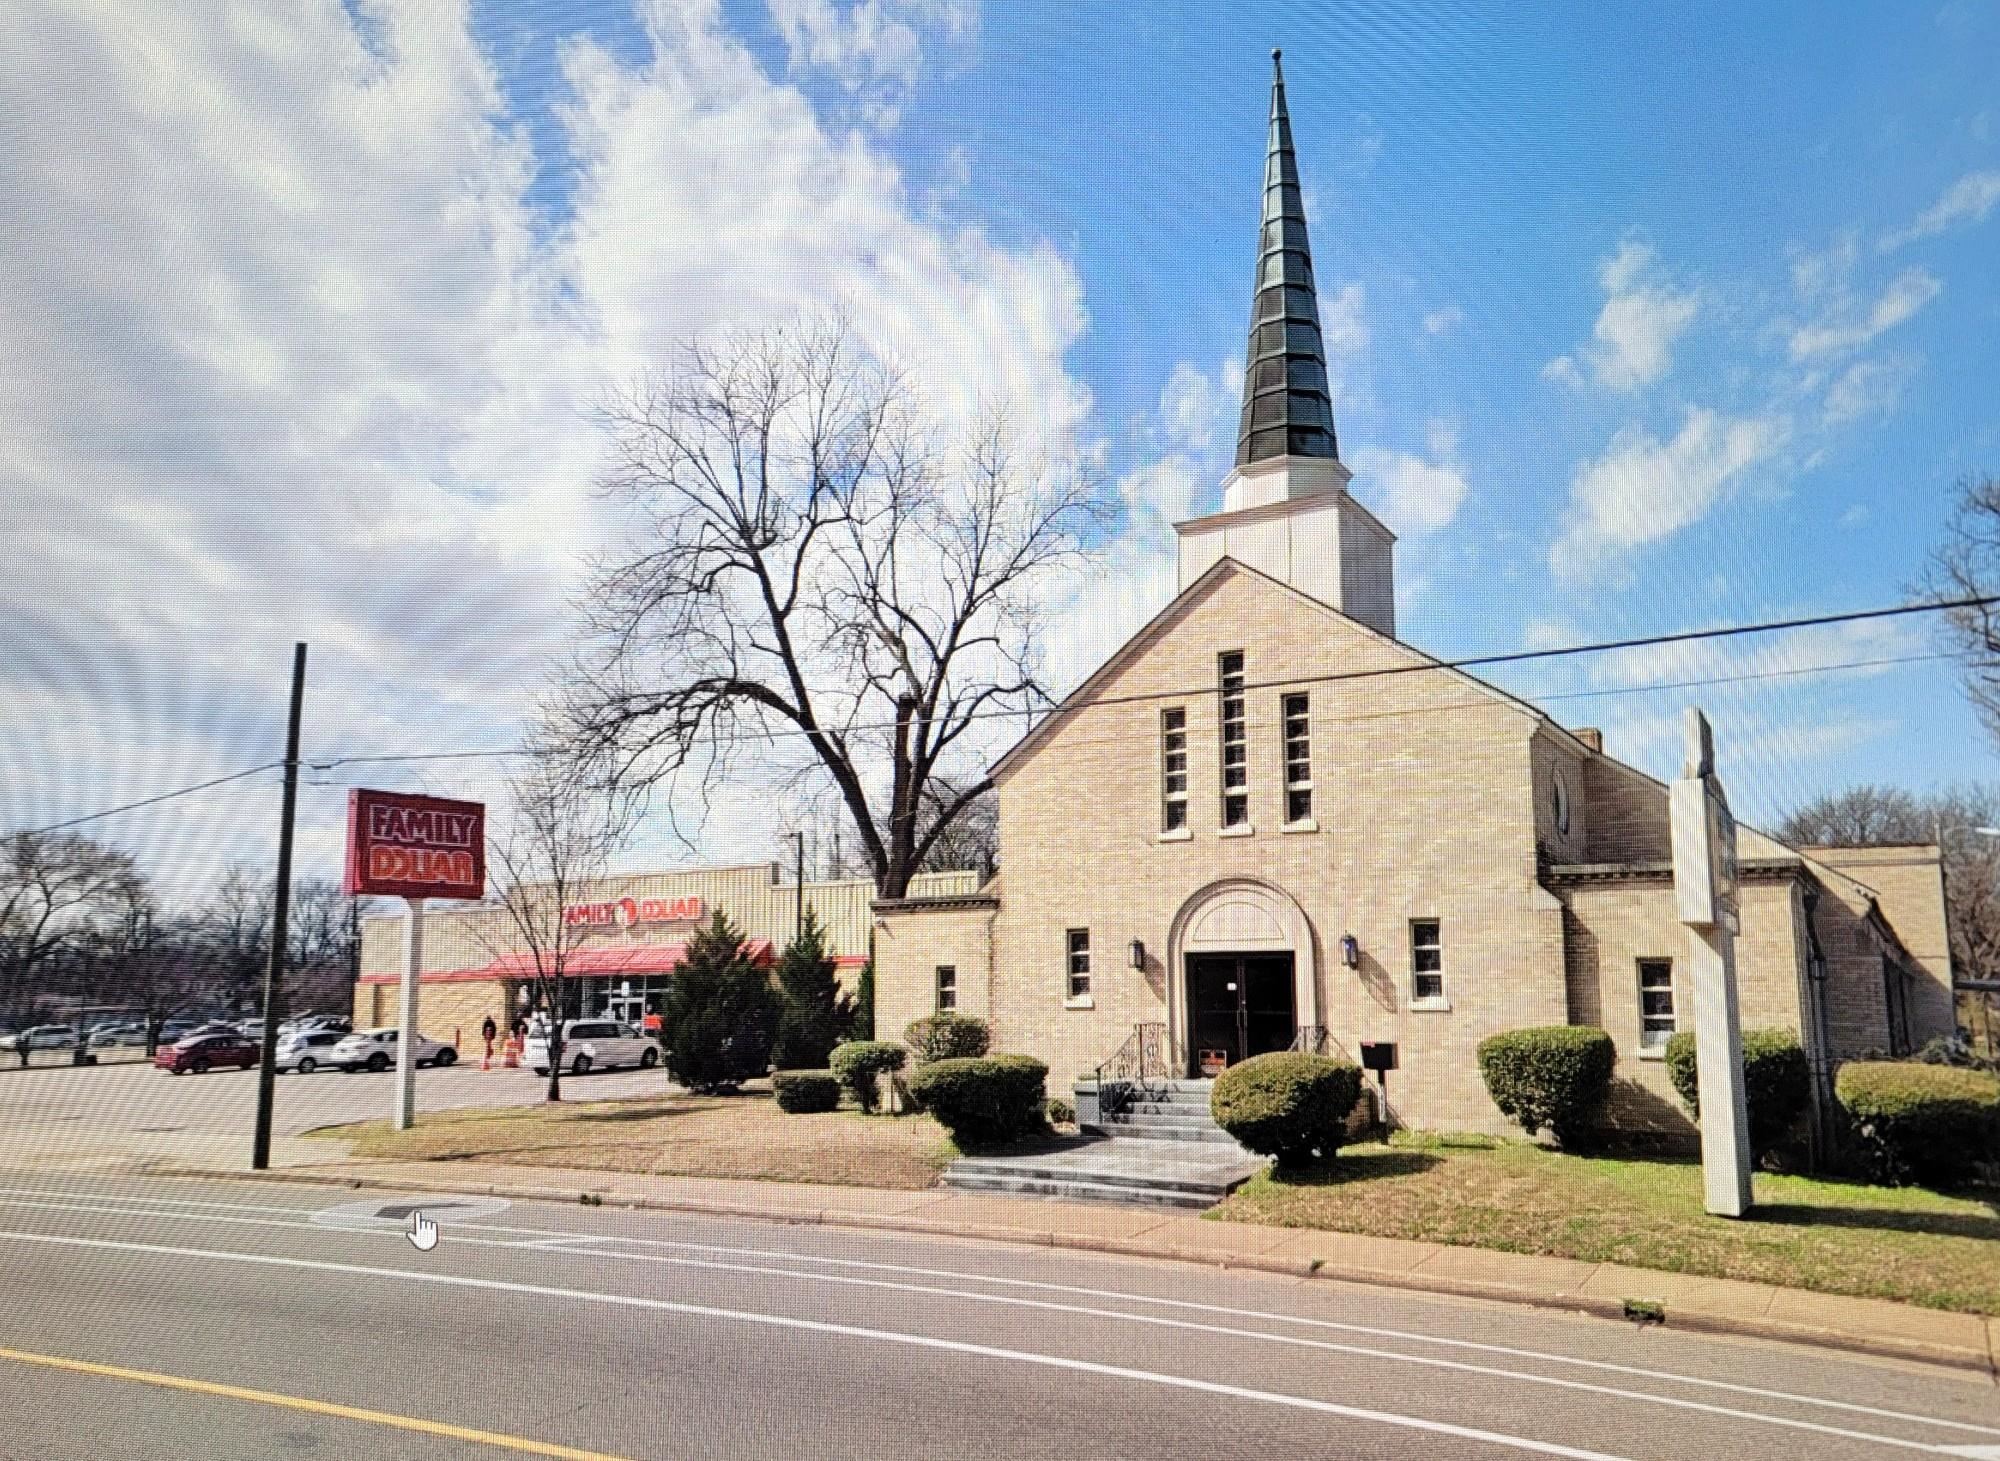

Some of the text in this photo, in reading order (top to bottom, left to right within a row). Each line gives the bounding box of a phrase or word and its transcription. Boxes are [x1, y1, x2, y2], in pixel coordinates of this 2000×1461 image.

[369, 804, 477, 847] FAMILY
[369, 844, 474, 884] DOLLAR
[562, 895, 702, 925] AMILY DOLLAR
